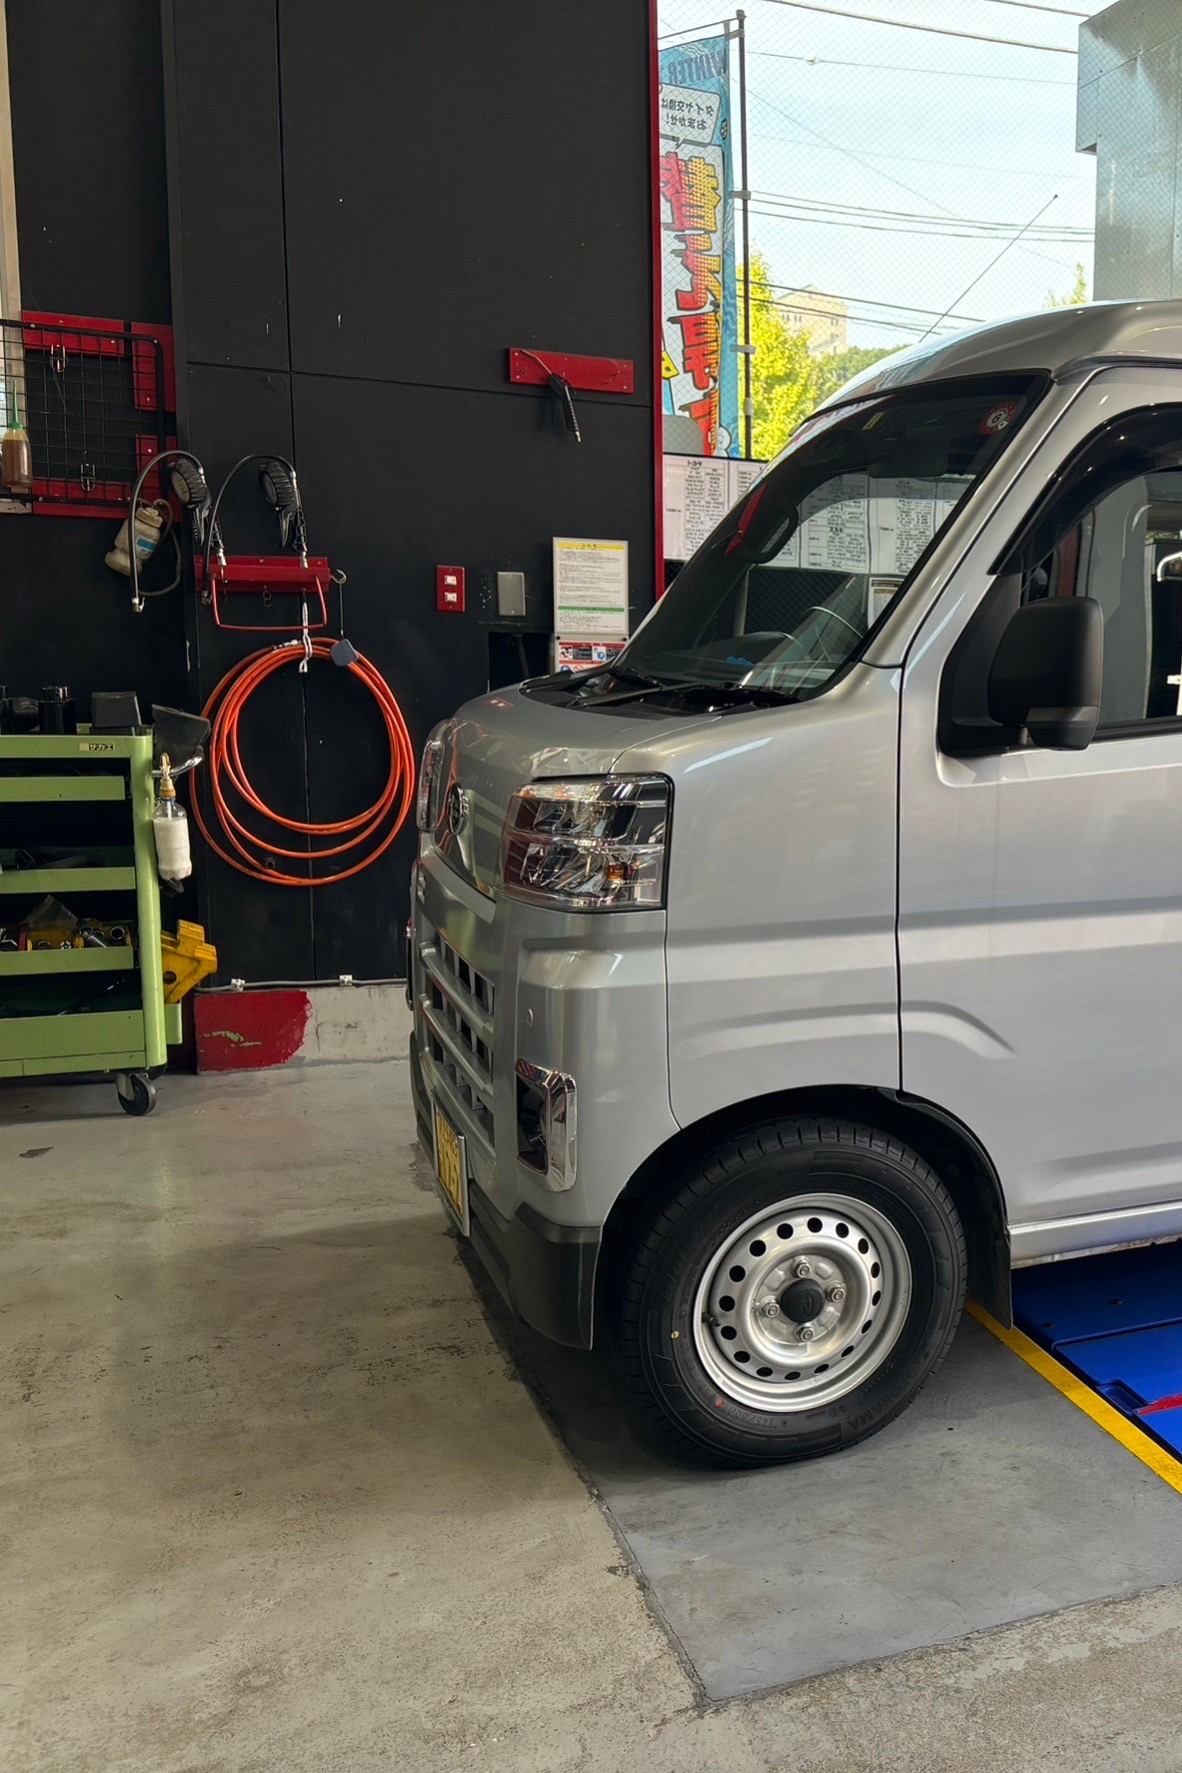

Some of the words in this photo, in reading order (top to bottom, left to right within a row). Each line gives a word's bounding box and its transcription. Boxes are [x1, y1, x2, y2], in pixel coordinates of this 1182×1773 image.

[89, 743, 113, 751] サカエ
[848, 1366, 923, 1430] YOKOHAMA
